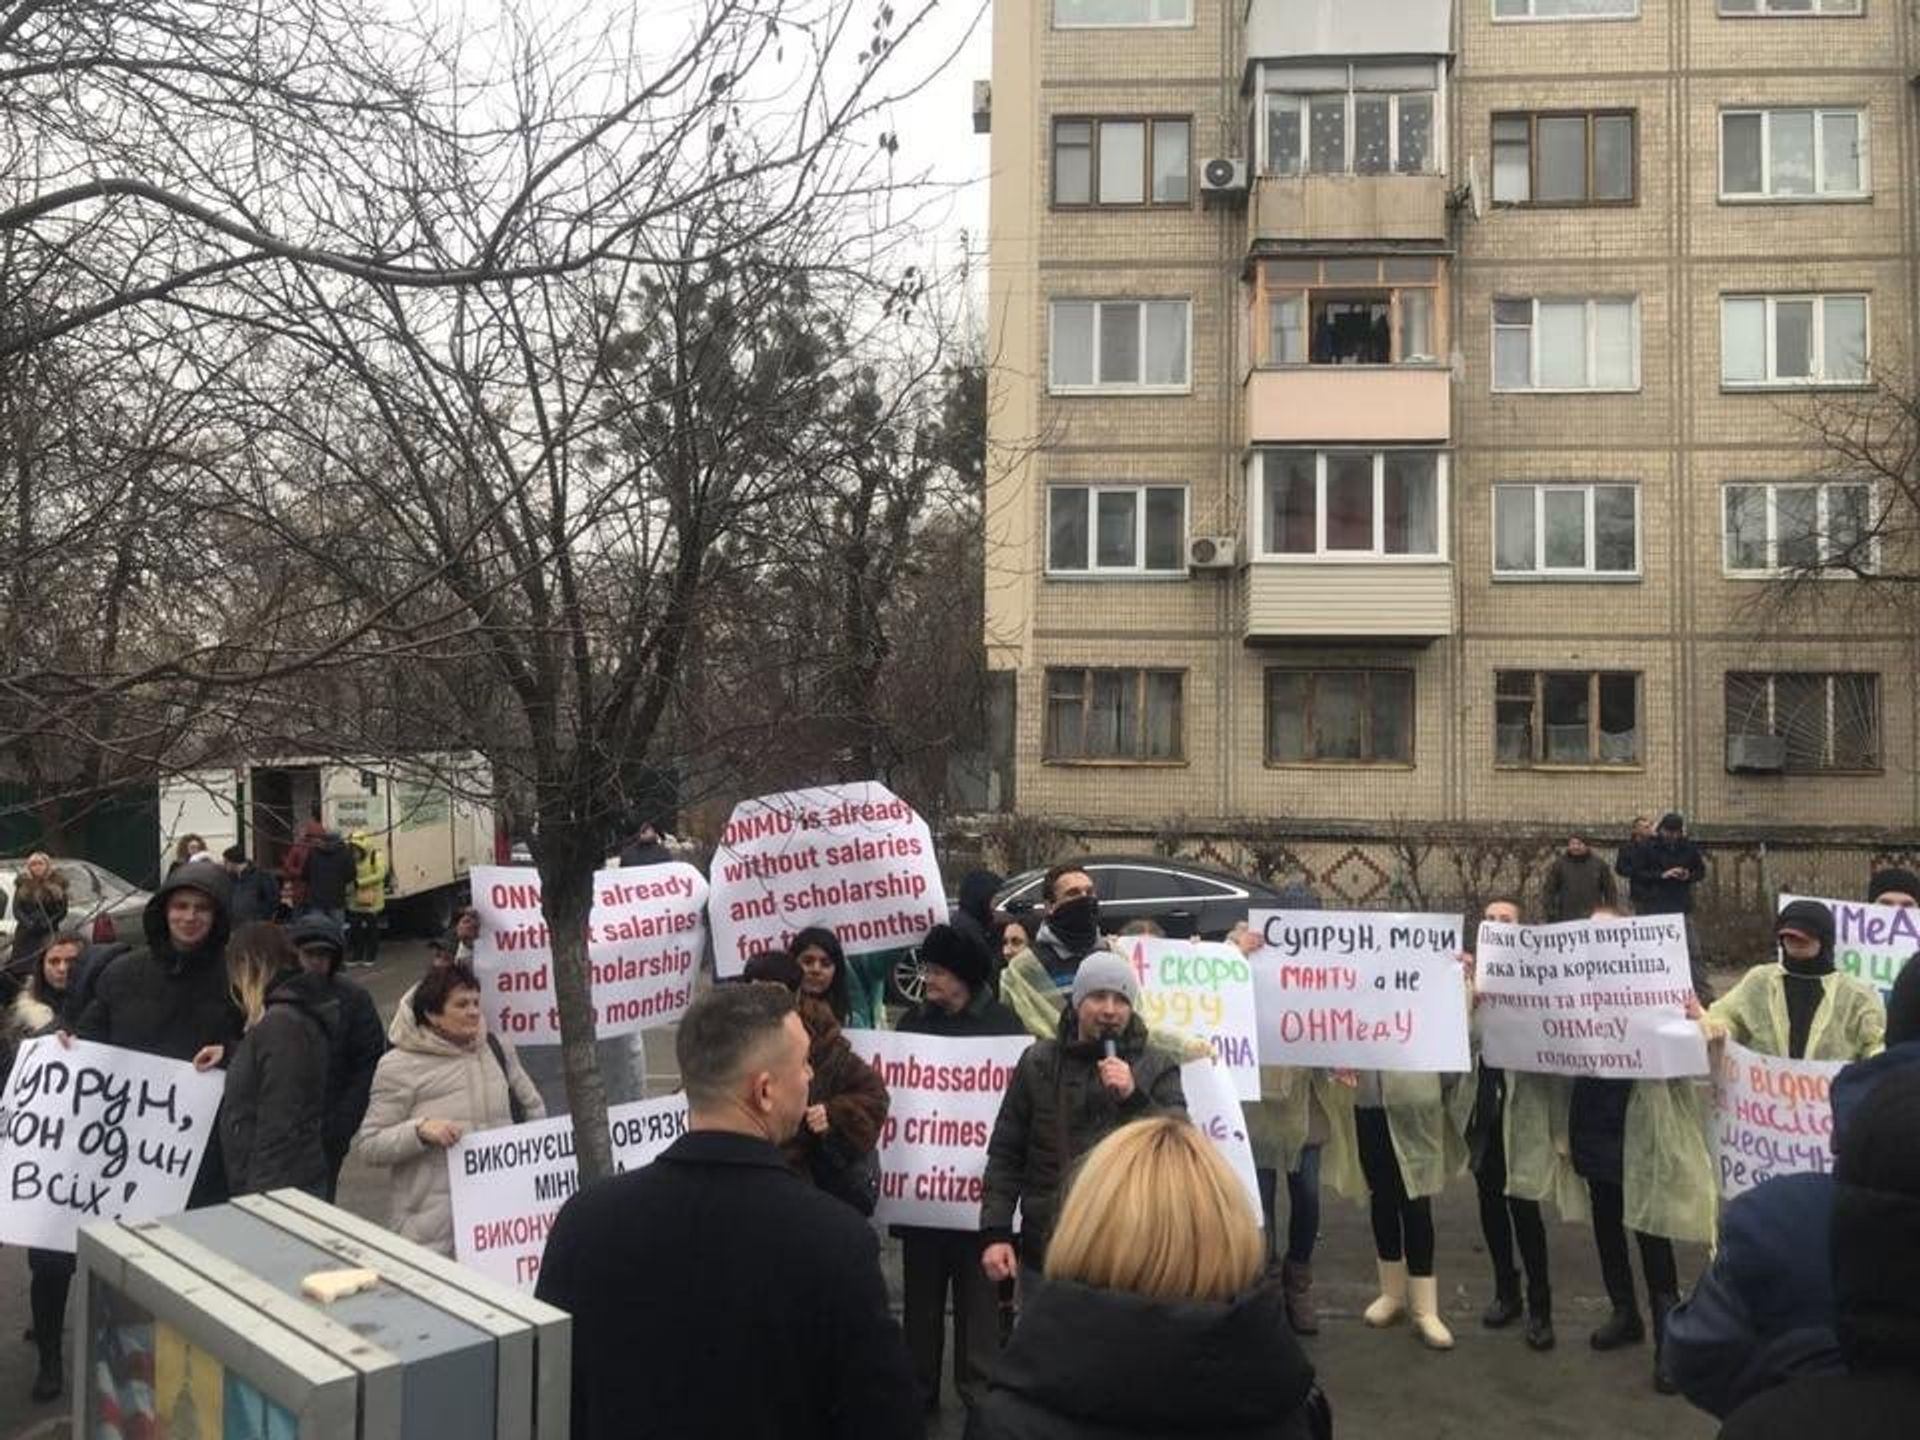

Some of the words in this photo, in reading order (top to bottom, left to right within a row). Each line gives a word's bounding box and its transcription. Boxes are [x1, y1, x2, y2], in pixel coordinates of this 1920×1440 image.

[723, 810, 792, 845] ONMU
[800, 806, 822, 830] is
[829, 799, 914, 827] already
[724, 847, 819, 882] without
[825, 833, 922, 866] salaries
[491, 884, 544, 909] ONM
[601, 876, 693, 907] already
[730, 891, 778, 921] and
[783, 870, 926, 912] scholarship
[604, 909, 698, 942] salaries
[737, 935, 774, 961] for
[835, 908, 935, 943] months!
[1519, 927, 1590, 956] Супрун
[497, 965, 548, 992] and
[589, 947, 692, 985] holarship
[1486, 961, 1515, 977] яка
[1520, 959, 1558, 985] ікра
[1564, 954, 1670, 981] корисніша,
[498, 1007, 540, 1032] for
[606, 983, 691, 1024] months!
[1554, 994, 1576, 1009] та
[1537, 1049, 1643, 1074] голодують!
[904, 1110, 988, 1147] crimes
[916, 1166, 988, 1203] citize
[473, 1214, 560, 1252] ВИКОНУ
[515, 1257, 541, 1284] ГР
